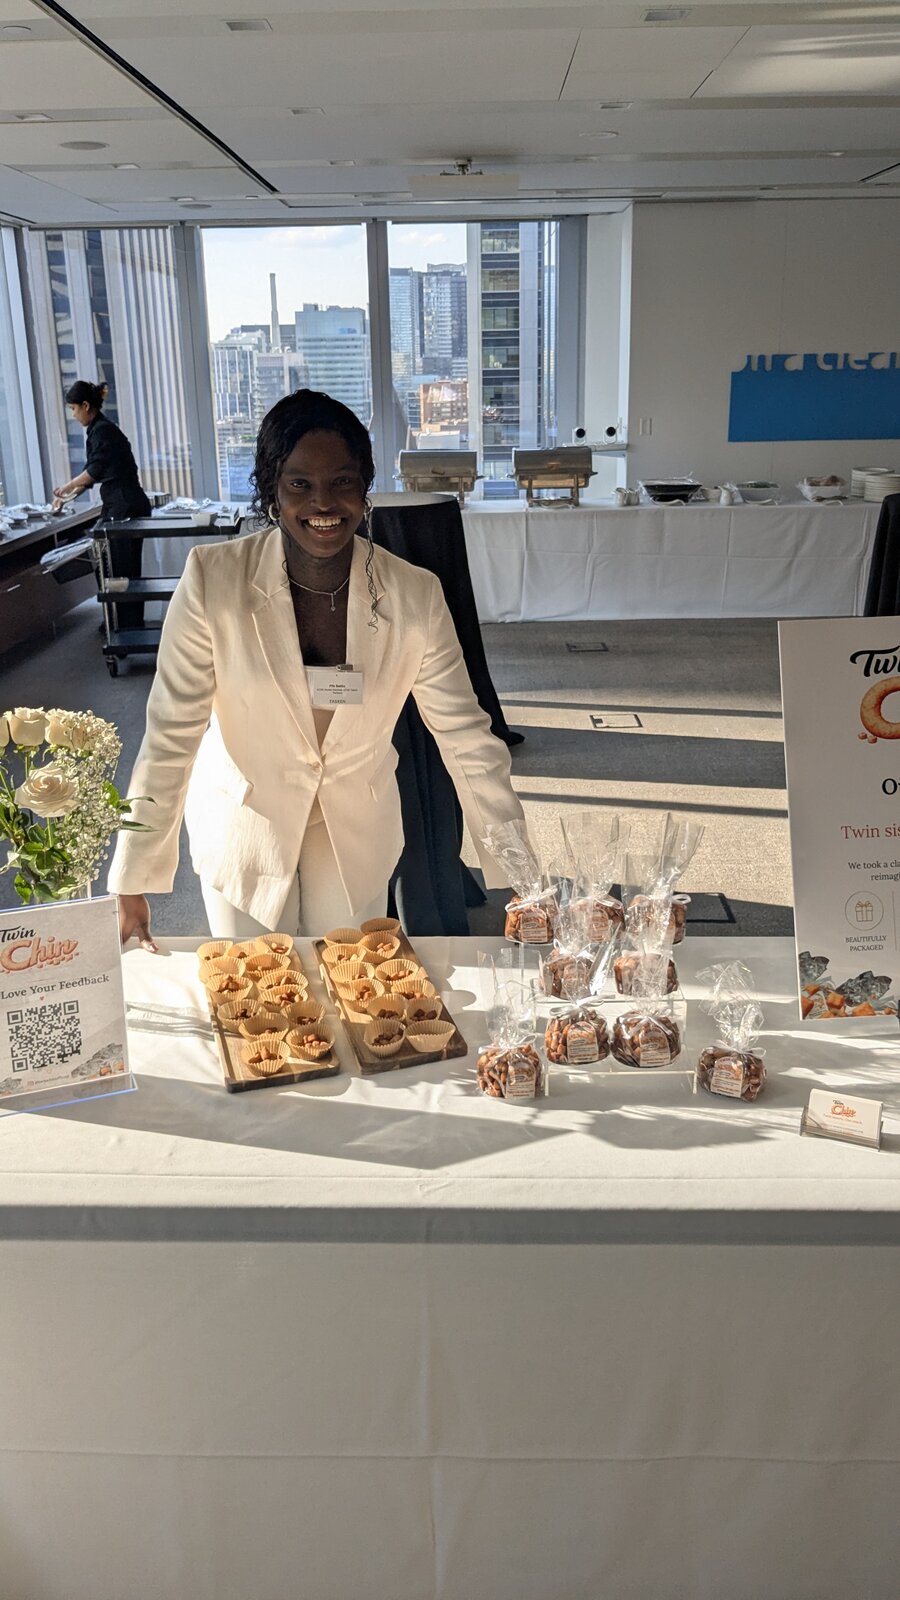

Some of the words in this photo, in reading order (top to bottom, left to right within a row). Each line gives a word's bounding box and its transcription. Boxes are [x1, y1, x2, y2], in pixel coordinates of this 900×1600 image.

[850, 645, 900, 677] Tw
[882, 778, 900, 795] O
[841, 824, 880, 839] Twin
[848, 861, 861, 869] We
[863, 860, 881, 869] took
[0, 926, 36, 943] Twin
[845, 935, 887, 943] BEAUTIFULLY
[1, 989, 27, 999] Love
[30, 983, 57, 995] Your
[60, 974, 110, 990] Feedback
